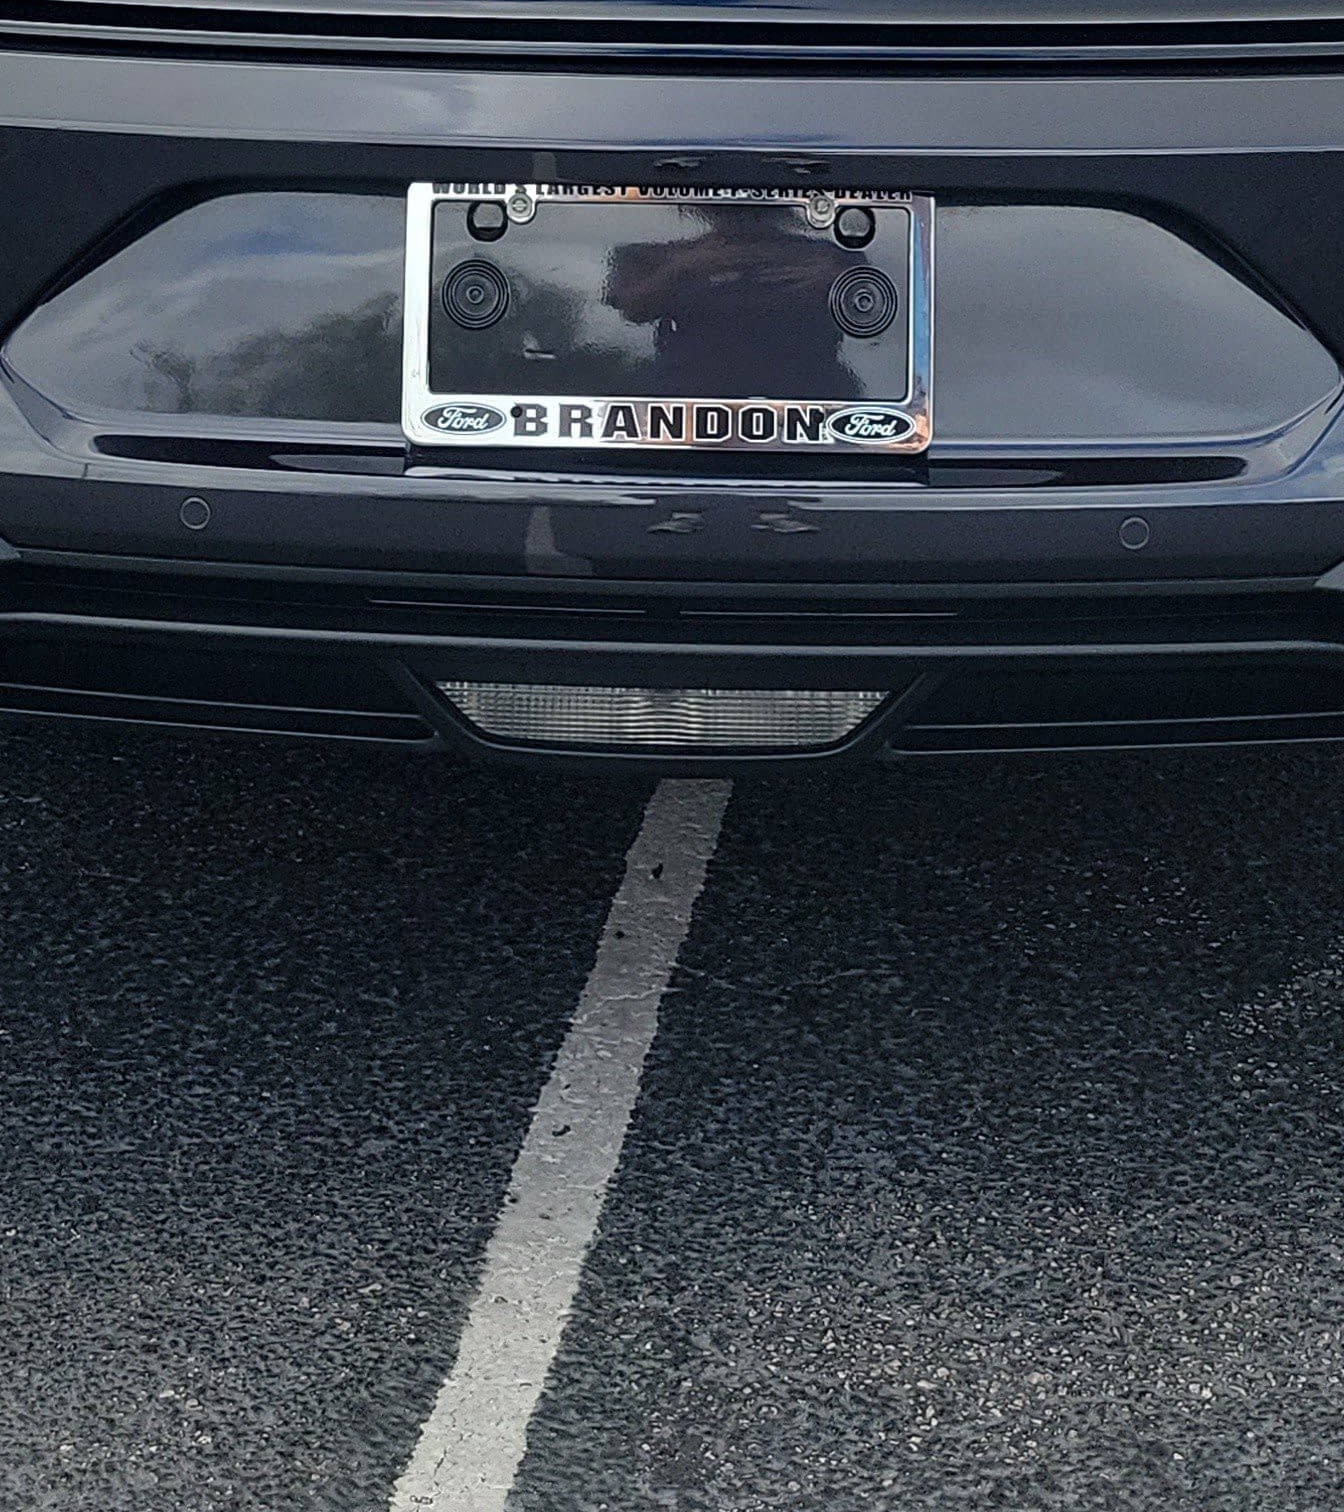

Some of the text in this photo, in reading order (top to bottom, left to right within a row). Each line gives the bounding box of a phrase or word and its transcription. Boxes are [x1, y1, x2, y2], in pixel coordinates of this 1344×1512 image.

[431, 182, 526, 195] WORLDS
[437, 402, 897, 443] Ford BRANDON Ford
